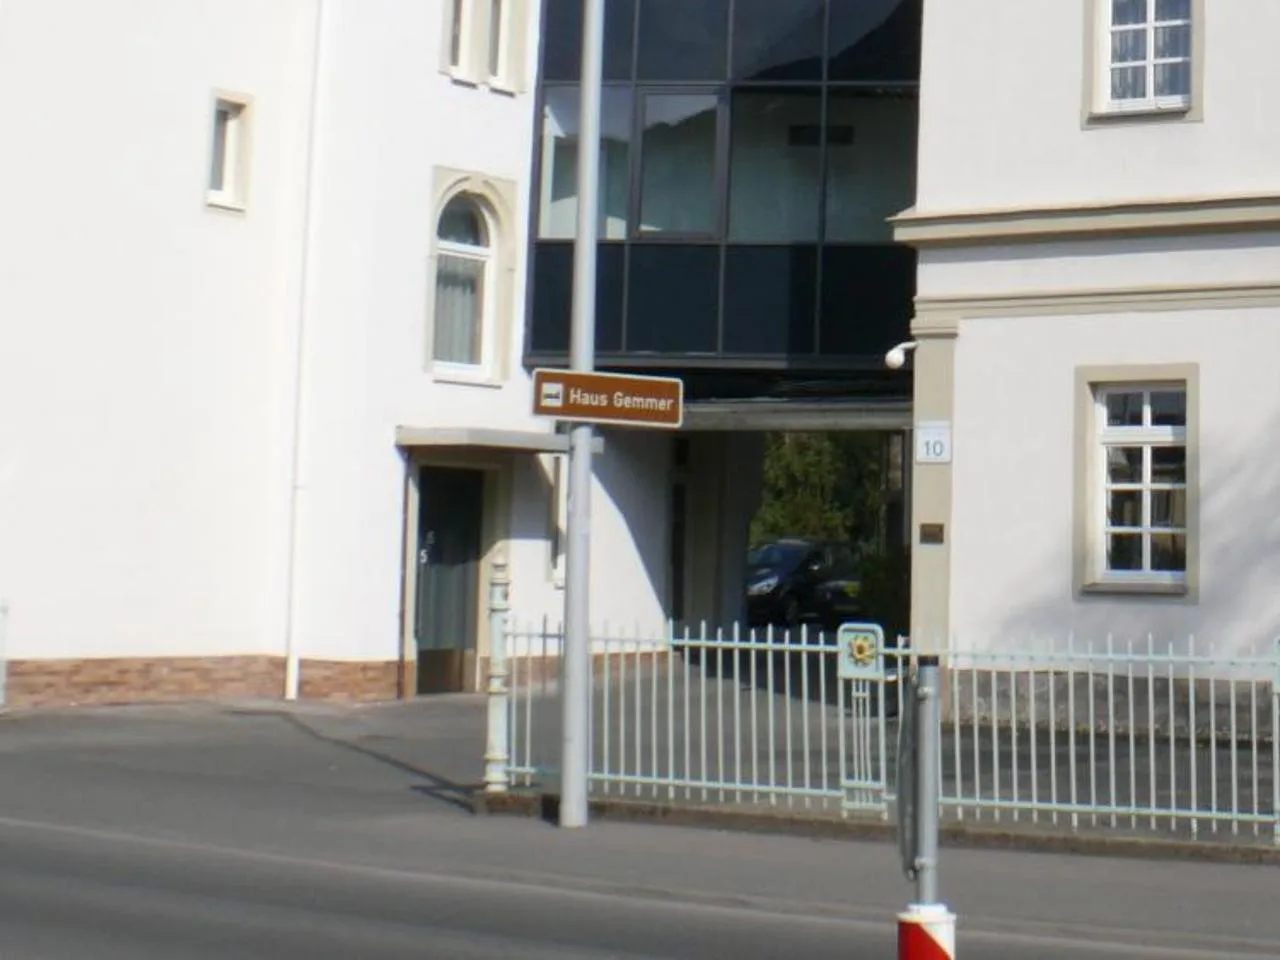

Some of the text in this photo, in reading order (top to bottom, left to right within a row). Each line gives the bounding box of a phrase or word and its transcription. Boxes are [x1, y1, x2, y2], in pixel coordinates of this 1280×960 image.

[569, 387, 674, 410] Haus Gemmer
[924, 439, 944, 456] 10
